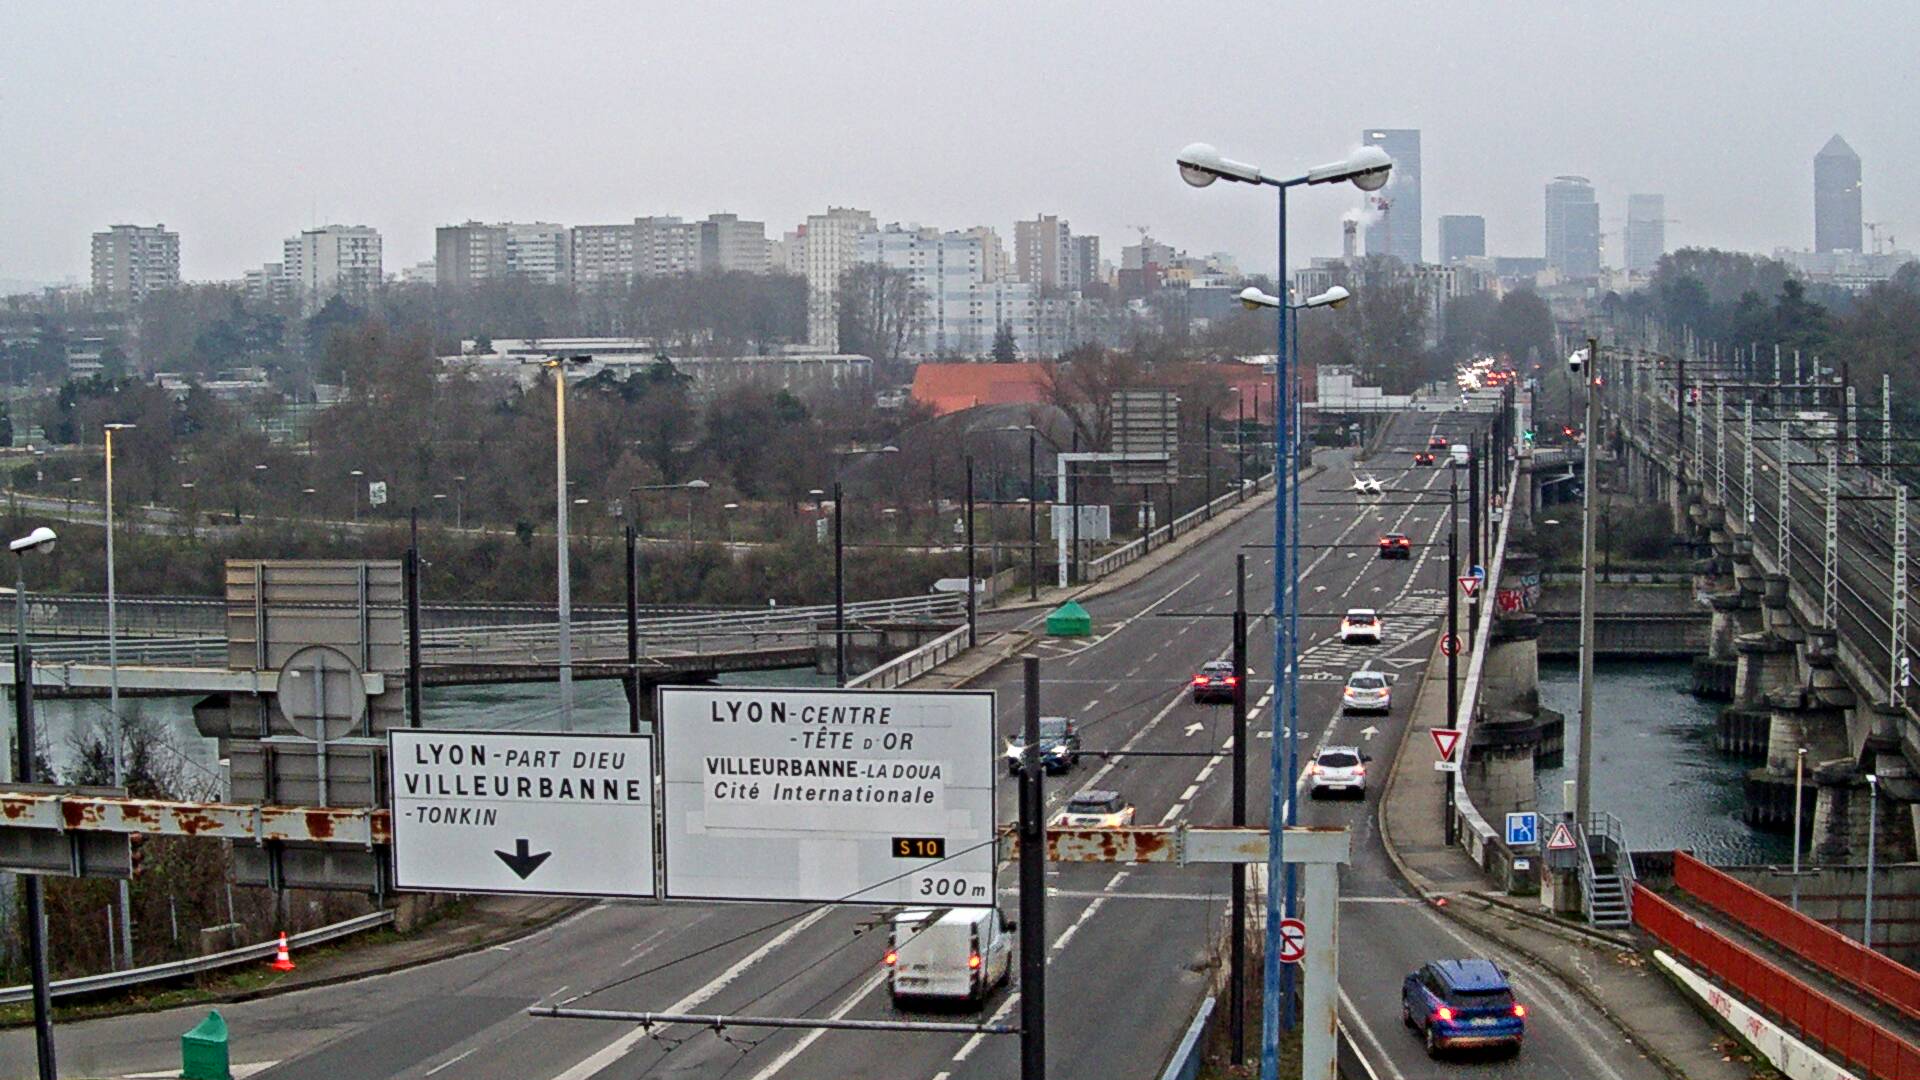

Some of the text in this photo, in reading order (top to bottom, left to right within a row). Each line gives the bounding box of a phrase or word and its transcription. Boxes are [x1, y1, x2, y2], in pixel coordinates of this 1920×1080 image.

[573, 751, 626, 770] DIEU
[893, 764, 942, 780] DOUA
[405, 773, 641, 801] VILLEURBANNE
[714, 781, 935, 804] Cité Internationale
[920, 877, 967, 897] 300
